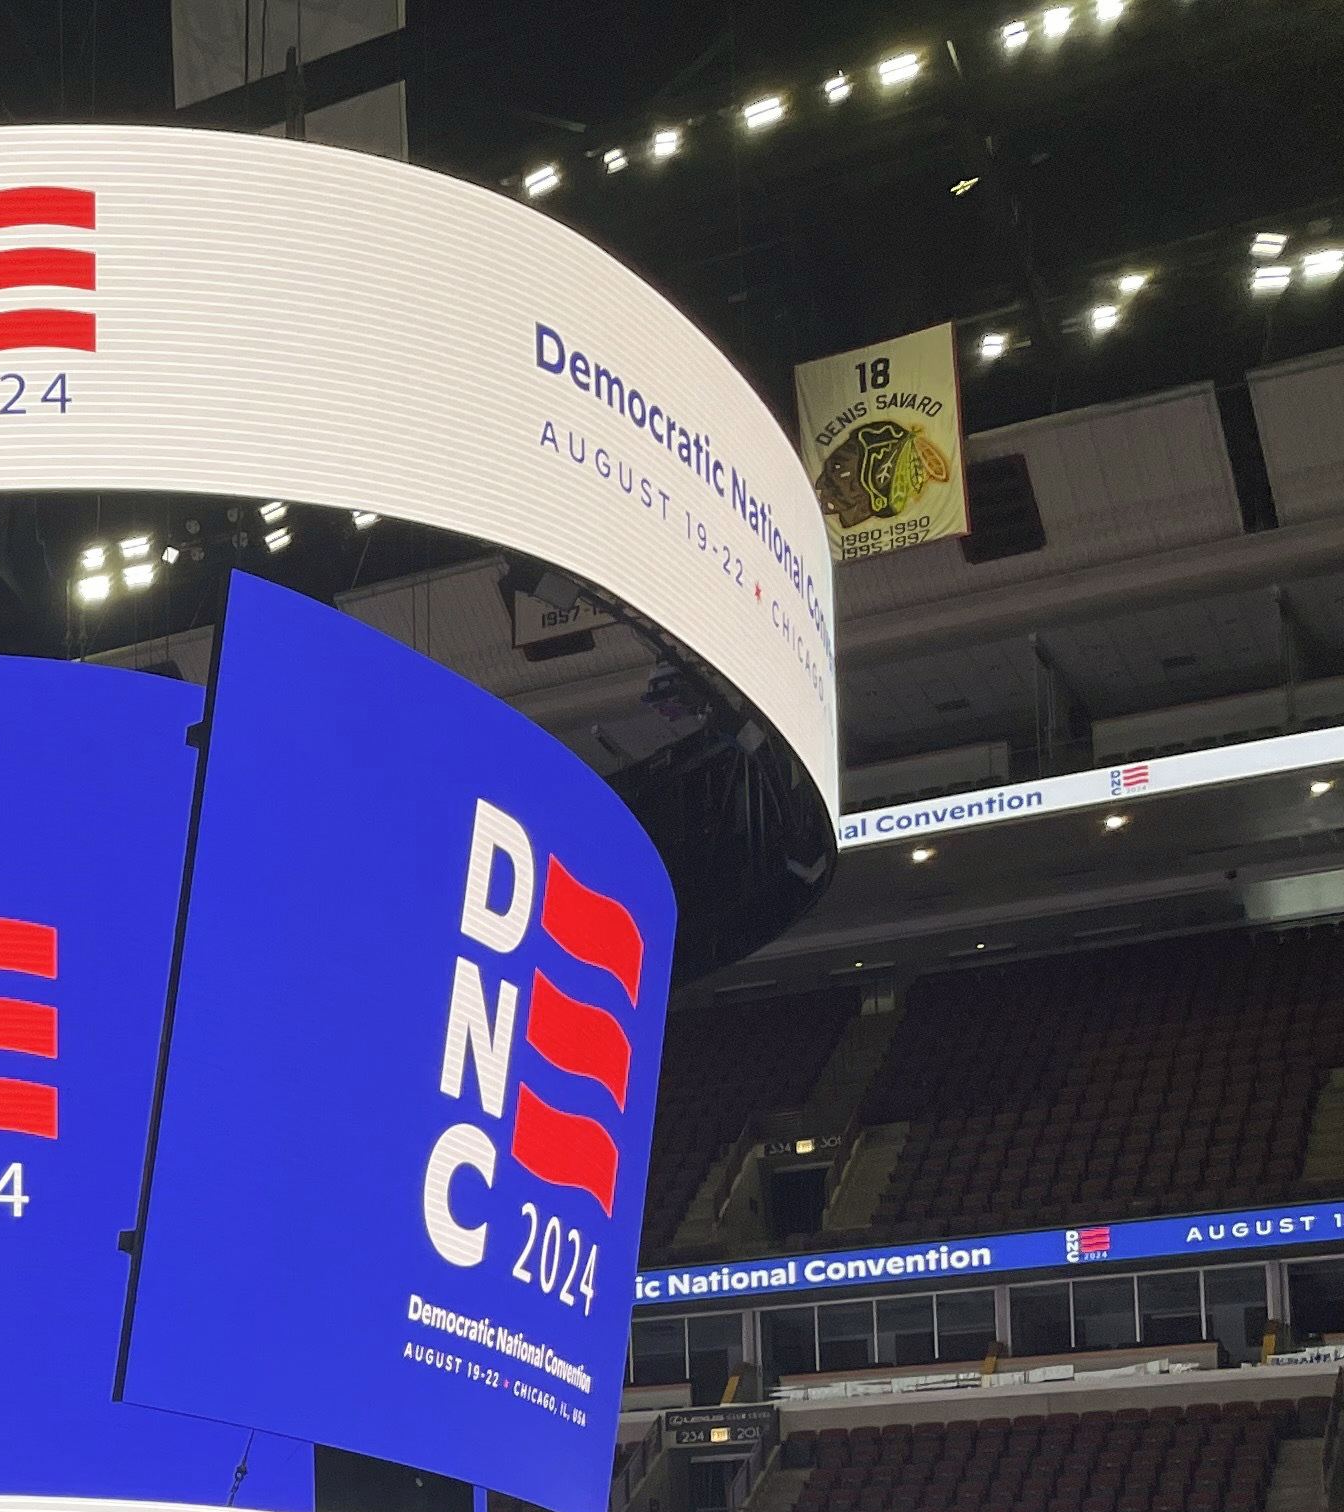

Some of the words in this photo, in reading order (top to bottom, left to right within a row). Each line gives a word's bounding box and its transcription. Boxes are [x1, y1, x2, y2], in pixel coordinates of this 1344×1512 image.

[854, 357, 891, 394] 18
[815, 402, 868, 449] DENIS
[875, 392, 944, 419] SAVARD
[534, 321, 726, 498] Democratic
[731, 466, 805, 601] National
[539, 420, 671, 522] AUGUST
[685, 510, 745, 588] 19-22
[840, 515, 931, 547] 1980-1990
[875, 788, 1043, 834] Convention
[1185, 1215, 1316, 1244] AUGUST
[511, 1201, 599, 1318] 2024
[668, 1260, 797, 1298] National
[803, 1242, 993, 1287] Convention
[407, 1293, 496, 1348] Democratic
[495, 1325, 545, 1370] National
[544, 1348, 592, 1395] Convention
[403, 1341, 463, 1375] AUGUST
[467, 1360, 500, 1389] 19-22
[512, 1379, 558, 1416] CHICAGO,
[572, 1407, 587, 1428] USA
